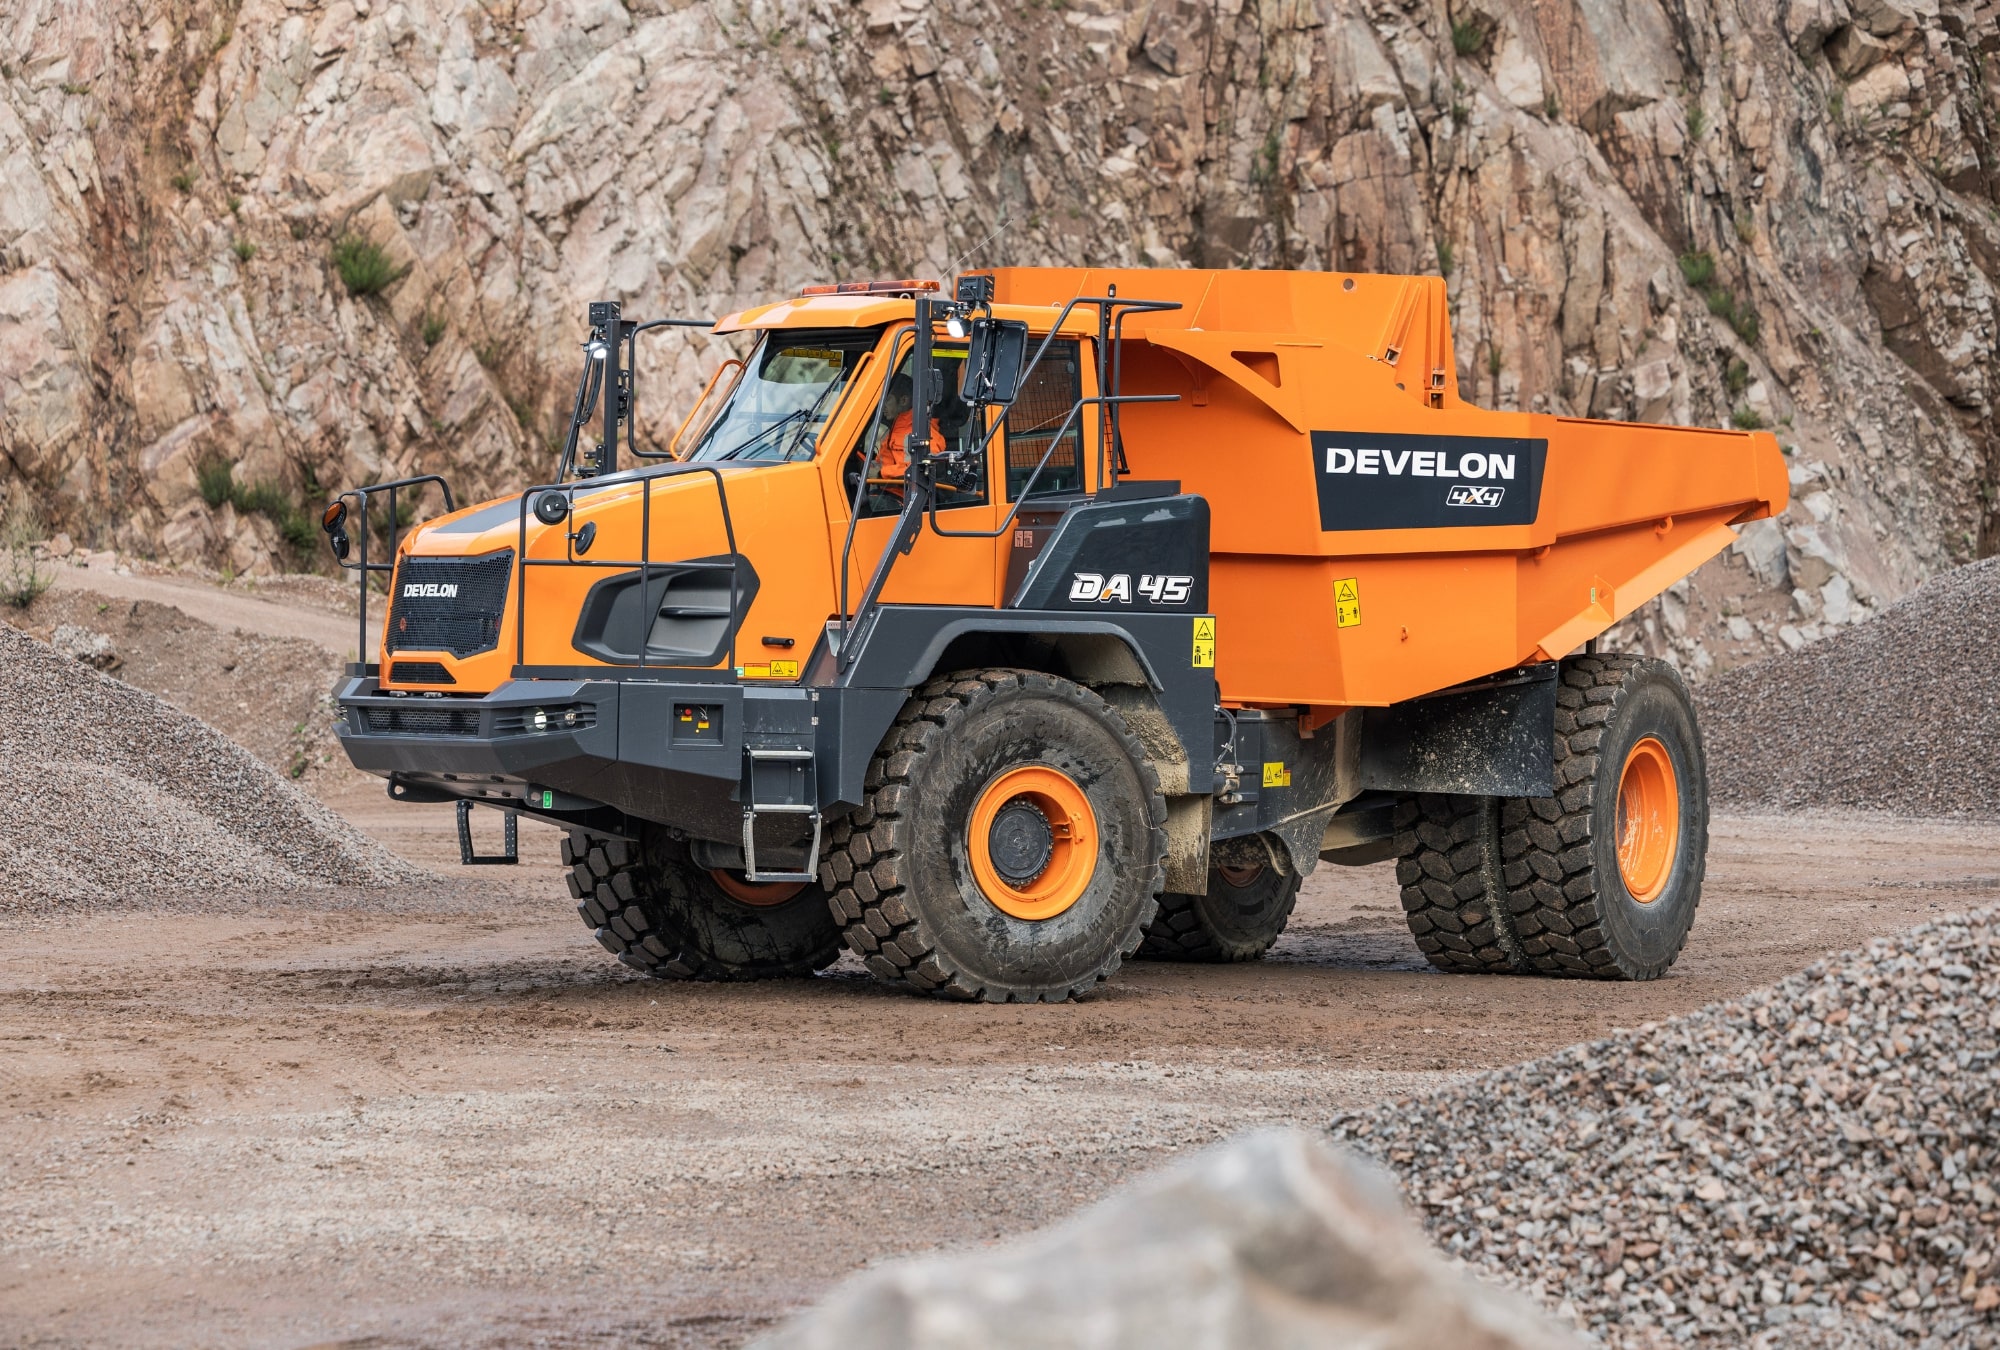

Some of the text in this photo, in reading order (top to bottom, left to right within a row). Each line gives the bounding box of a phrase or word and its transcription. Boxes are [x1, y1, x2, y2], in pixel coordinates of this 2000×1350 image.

[1325, 447, 1516, 480] DEVELON
[403, 583, 458, 598] DEVELON
[1069, 572, 1194, 604] DA 45
